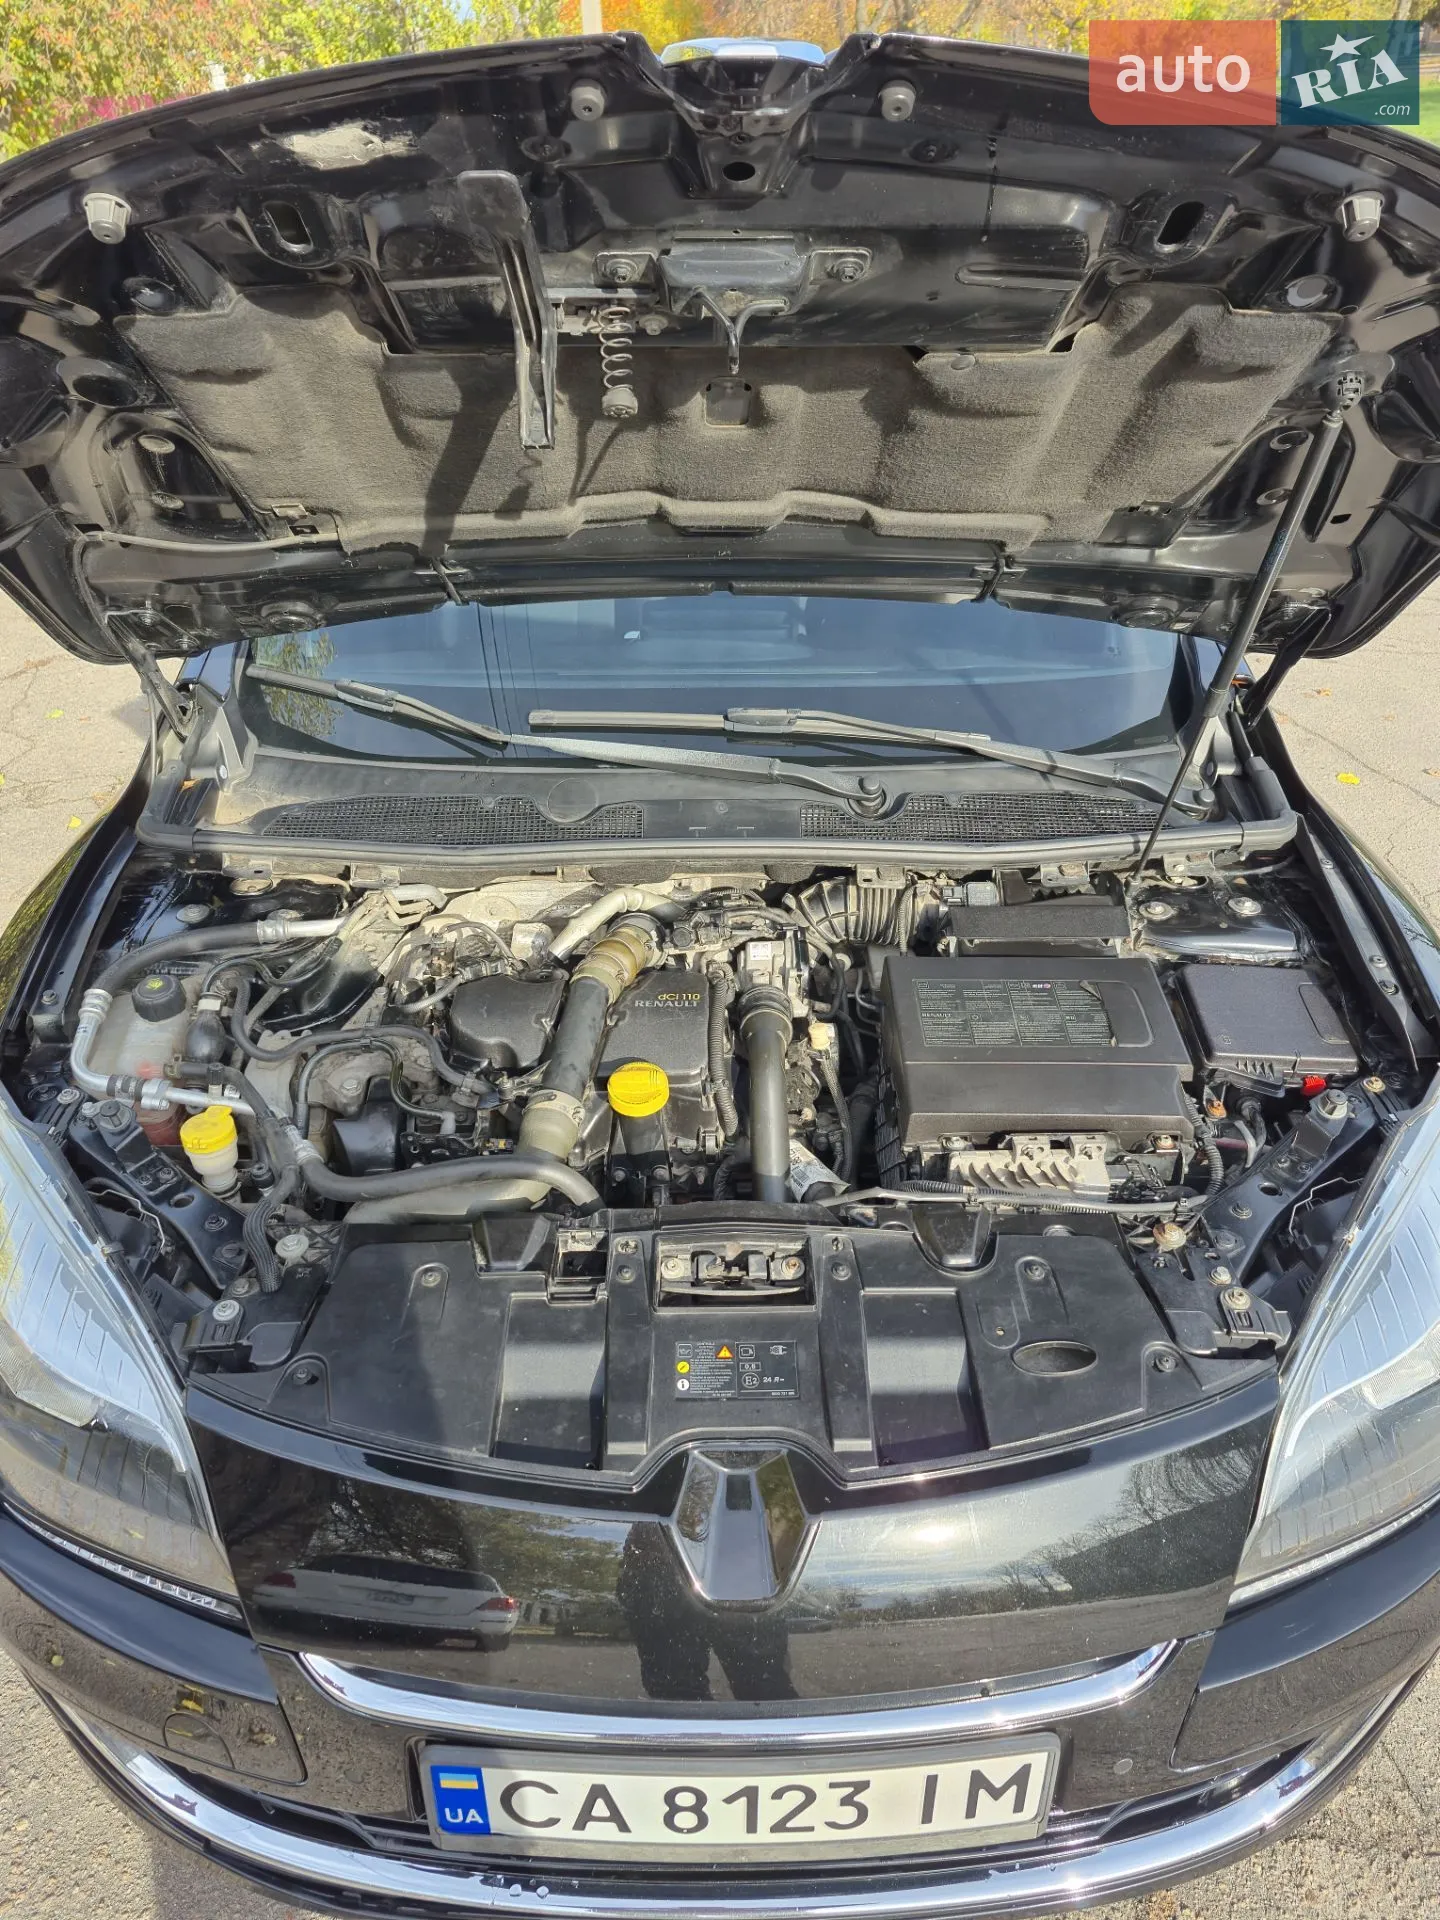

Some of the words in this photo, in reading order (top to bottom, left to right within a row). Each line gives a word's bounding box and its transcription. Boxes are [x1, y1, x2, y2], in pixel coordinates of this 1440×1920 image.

[657, 993, 679, 1001] dCi
[682, 993, 700, 1001] 110
[500, 1780, 632, 1833] CA
[663, 1779, 871, 1834] 8123
[444, 1807, 484, 1824] UA
